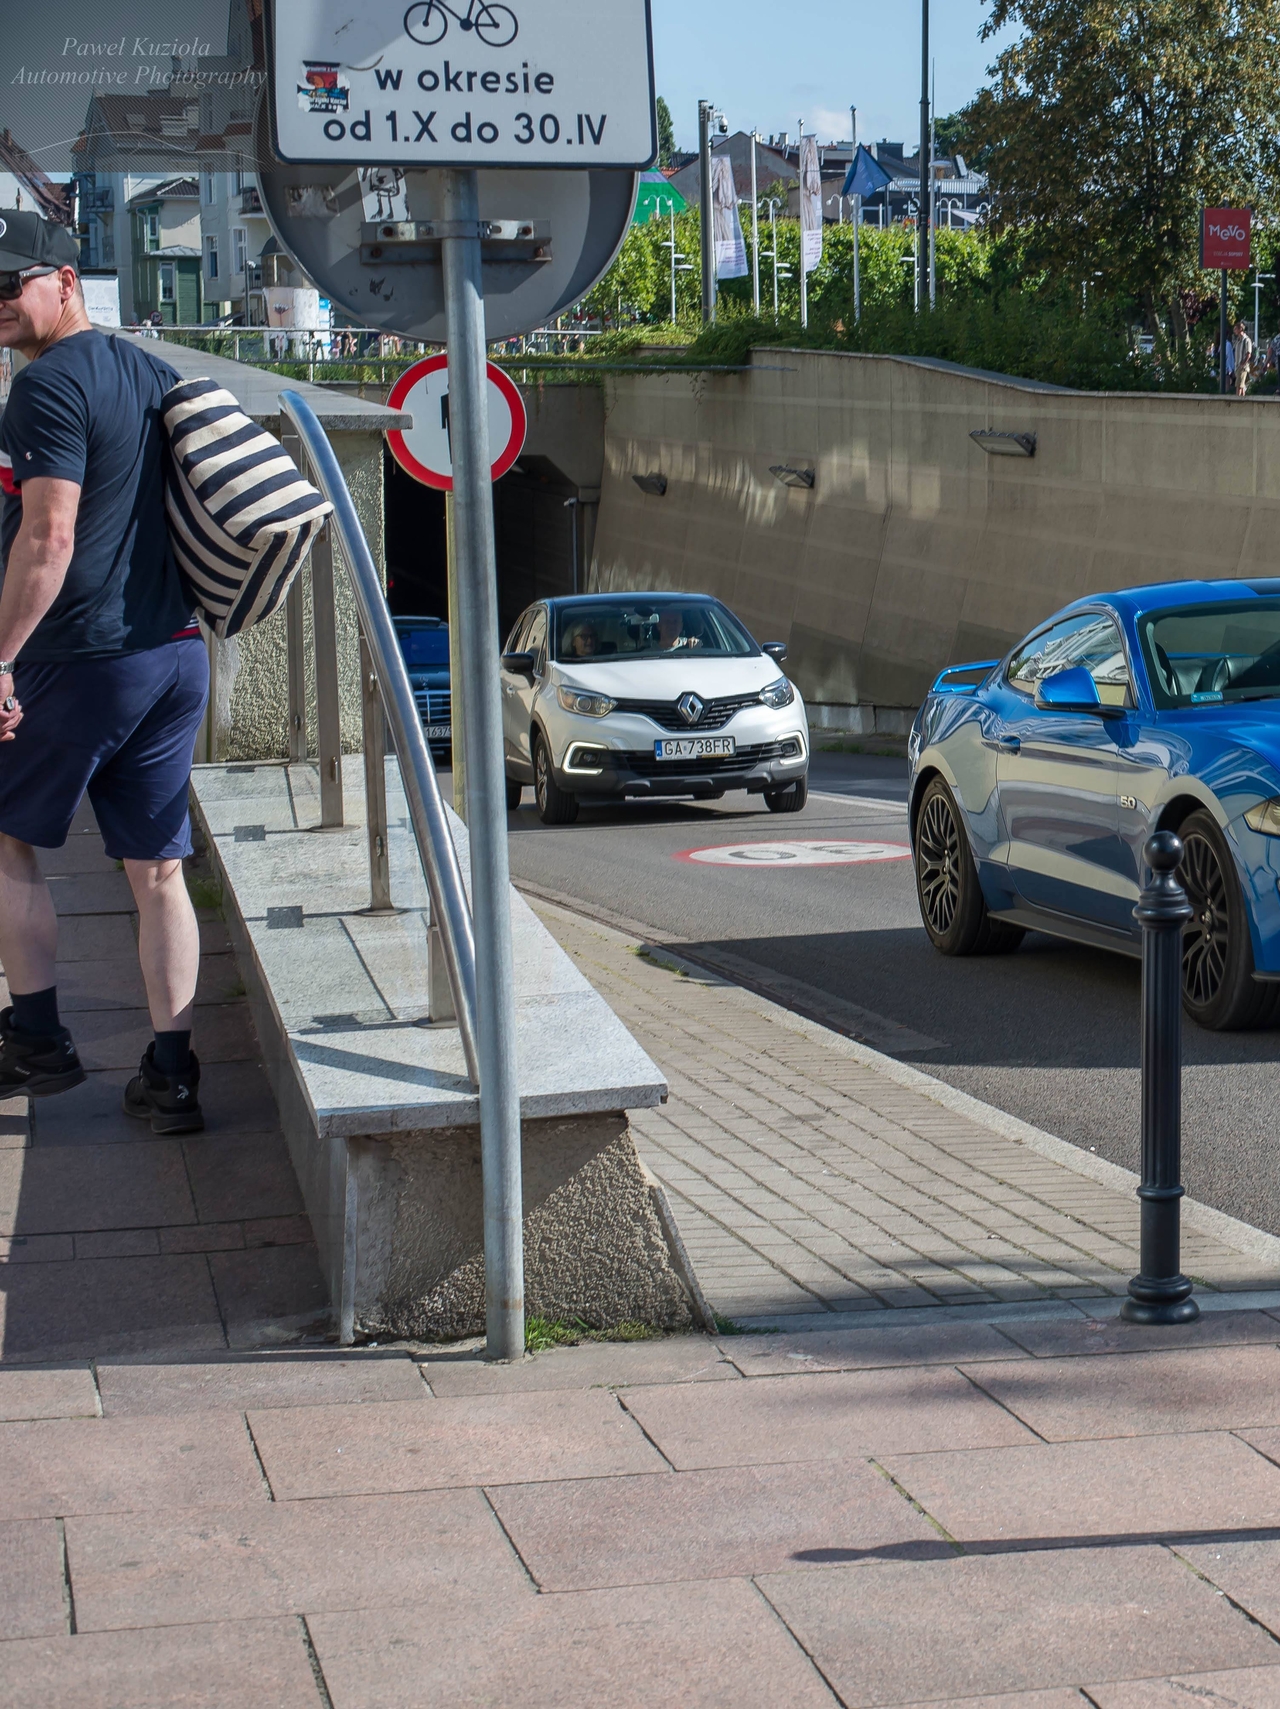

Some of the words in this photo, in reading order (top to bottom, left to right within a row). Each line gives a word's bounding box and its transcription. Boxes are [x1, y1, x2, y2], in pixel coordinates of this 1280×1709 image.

[374, 68, 403, 91] w
[416, 60, 554, 93] okresie
[323, 110, 371, 142] od
[385, 110, 438, 143] 1.X
[450, 111, 499, 144] do
[513, 112, 607, 145] 30.IV
[665, 740, 683, 756] GA
[688, 739, 731, 755] 738FR
